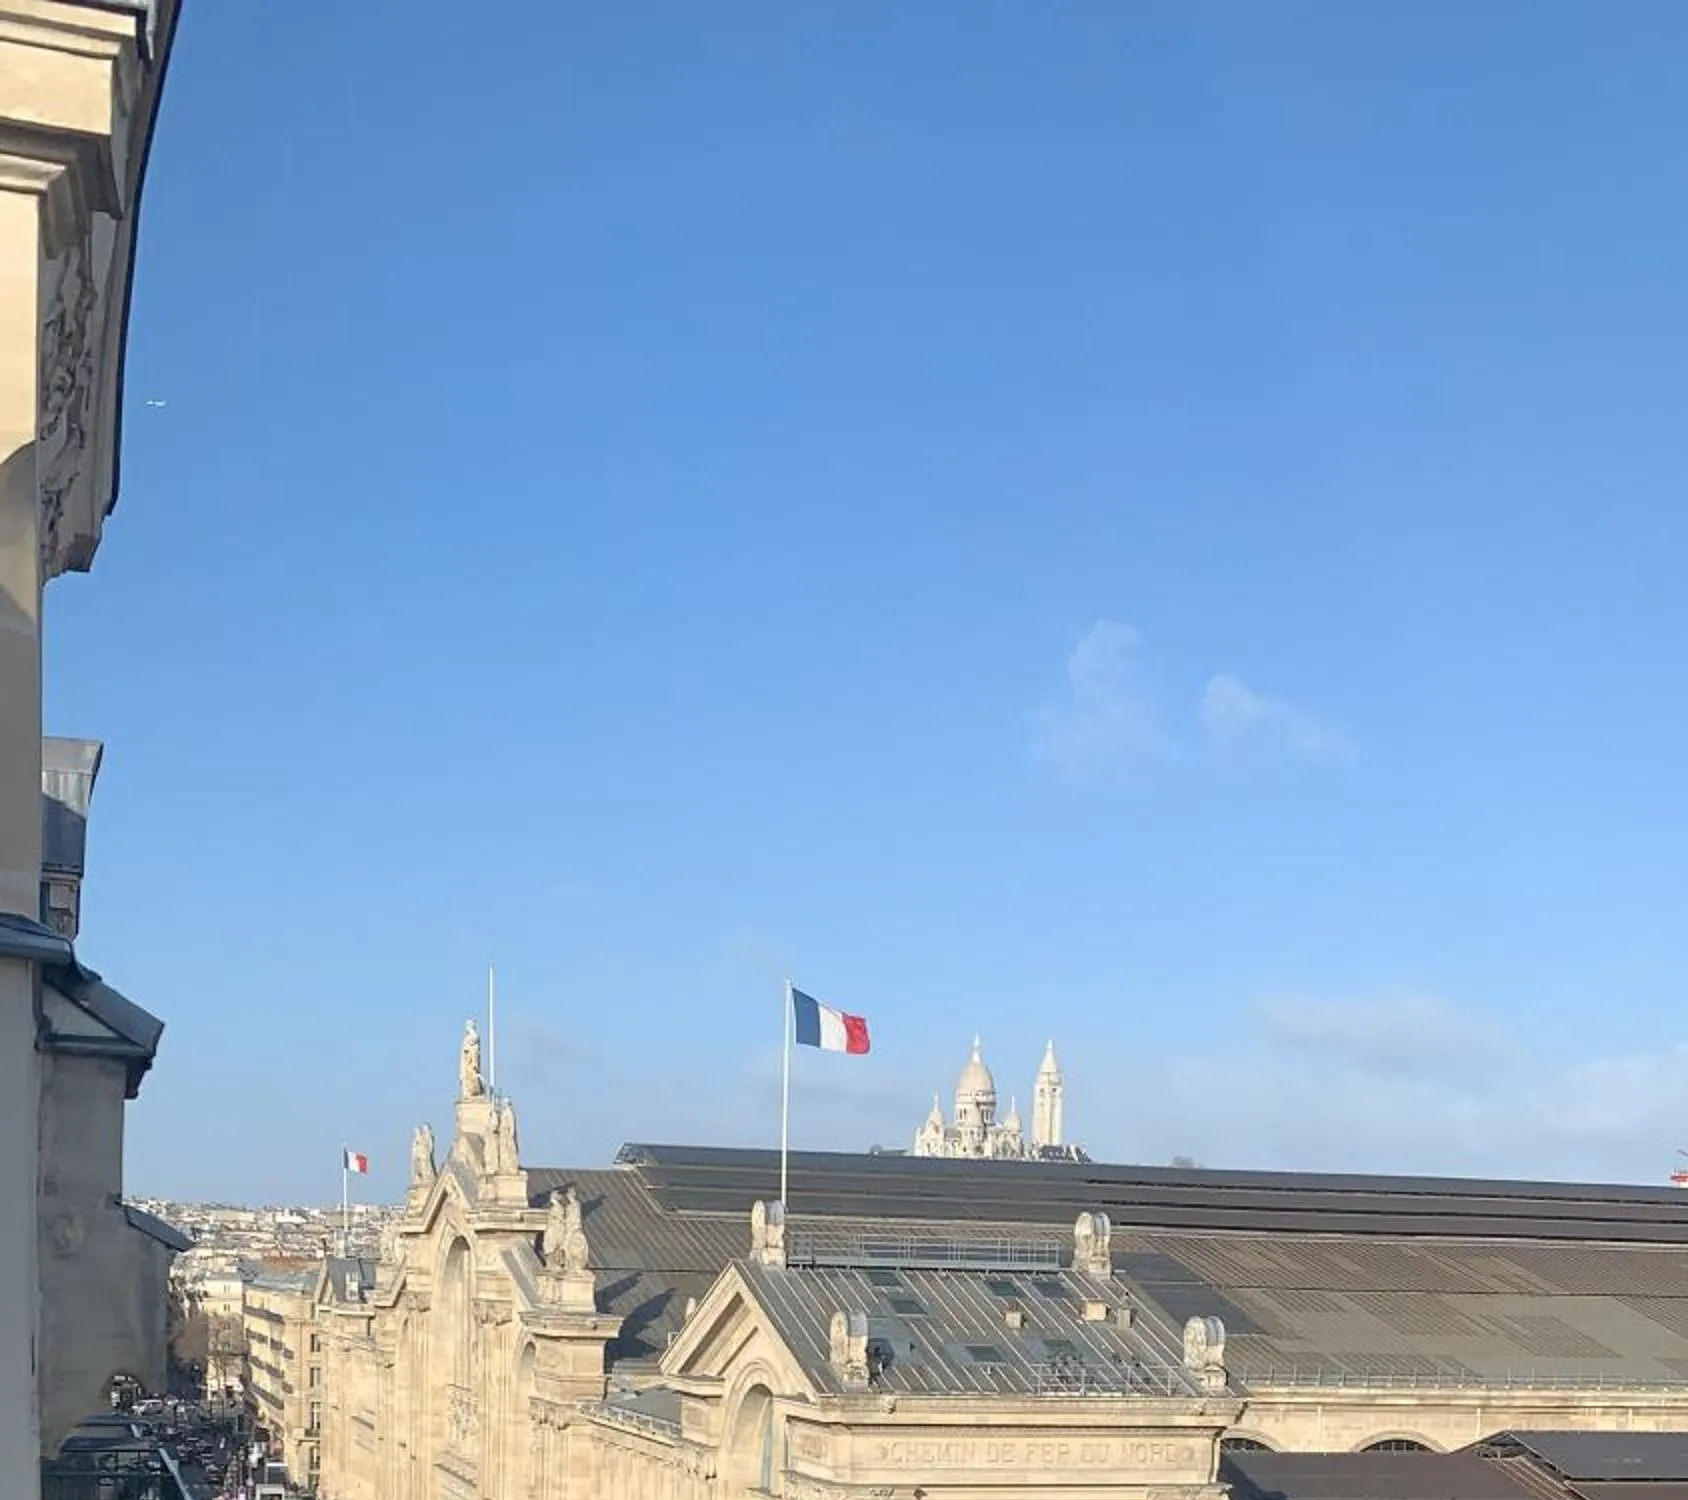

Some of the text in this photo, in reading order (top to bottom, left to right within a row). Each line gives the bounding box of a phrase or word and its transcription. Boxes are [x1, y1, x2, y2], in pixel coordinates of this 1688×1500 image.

[890, 1442, 1176, 1464] CHEMIN DE FER DU NORD
